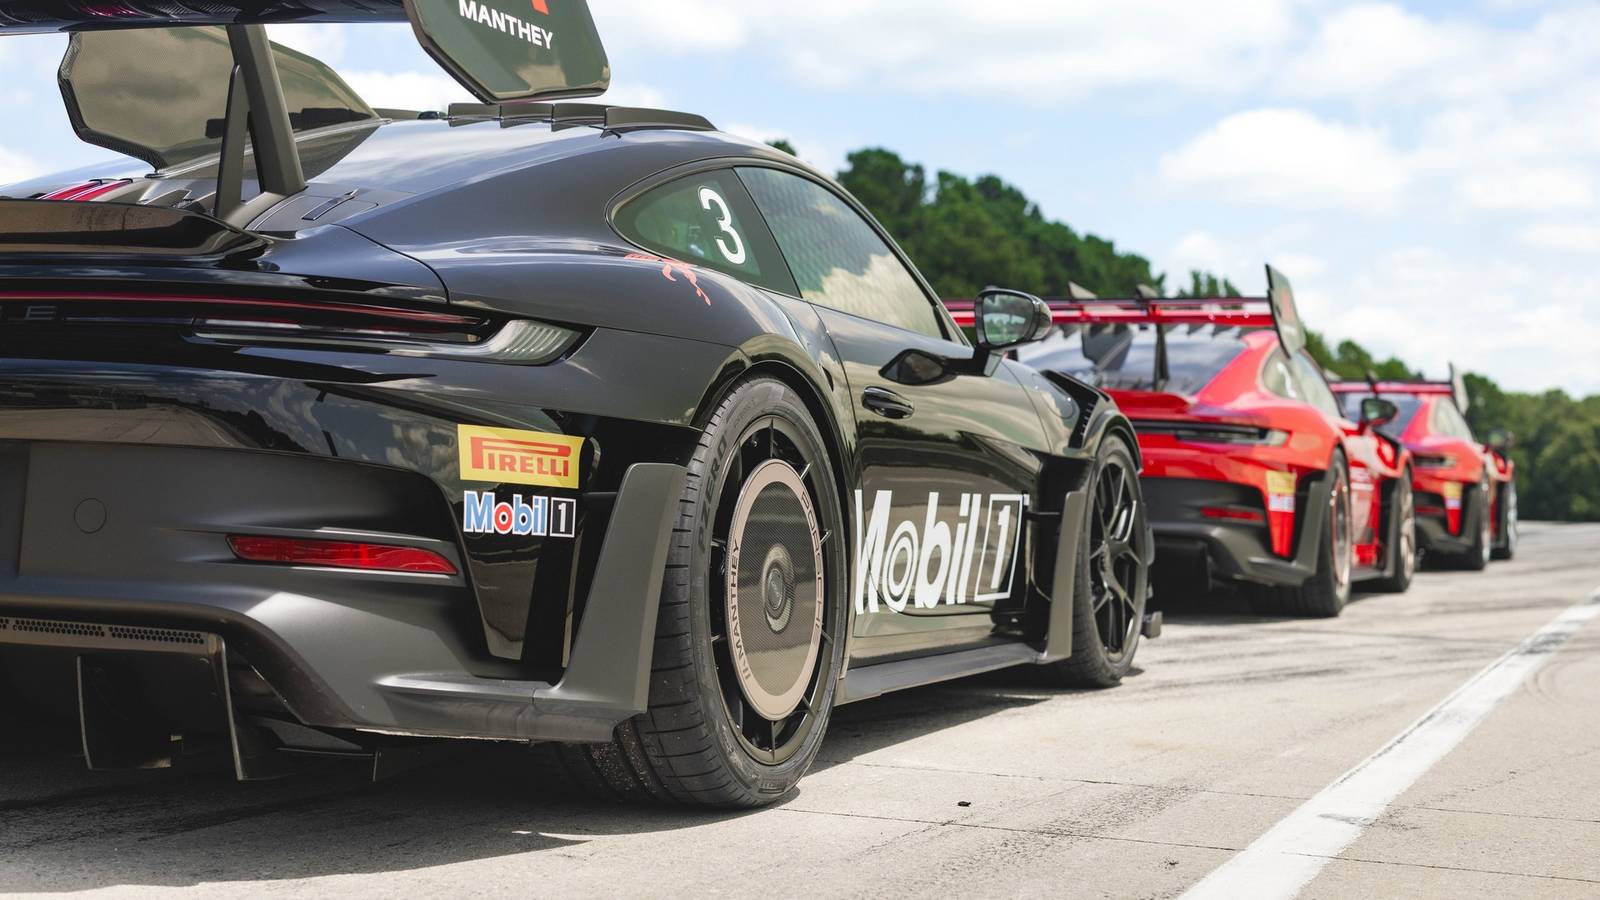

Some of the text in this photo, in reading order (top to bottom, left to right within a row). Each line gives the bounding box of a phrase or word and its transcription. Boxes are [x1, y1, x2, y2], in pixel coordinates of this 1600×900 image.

[459, 0, 553, 49] MANTHEY
[698, 186, 746, 265] 3
[470, 436, 572, 477] PIRELLI
[463, 490, 548, 536] Mobil
